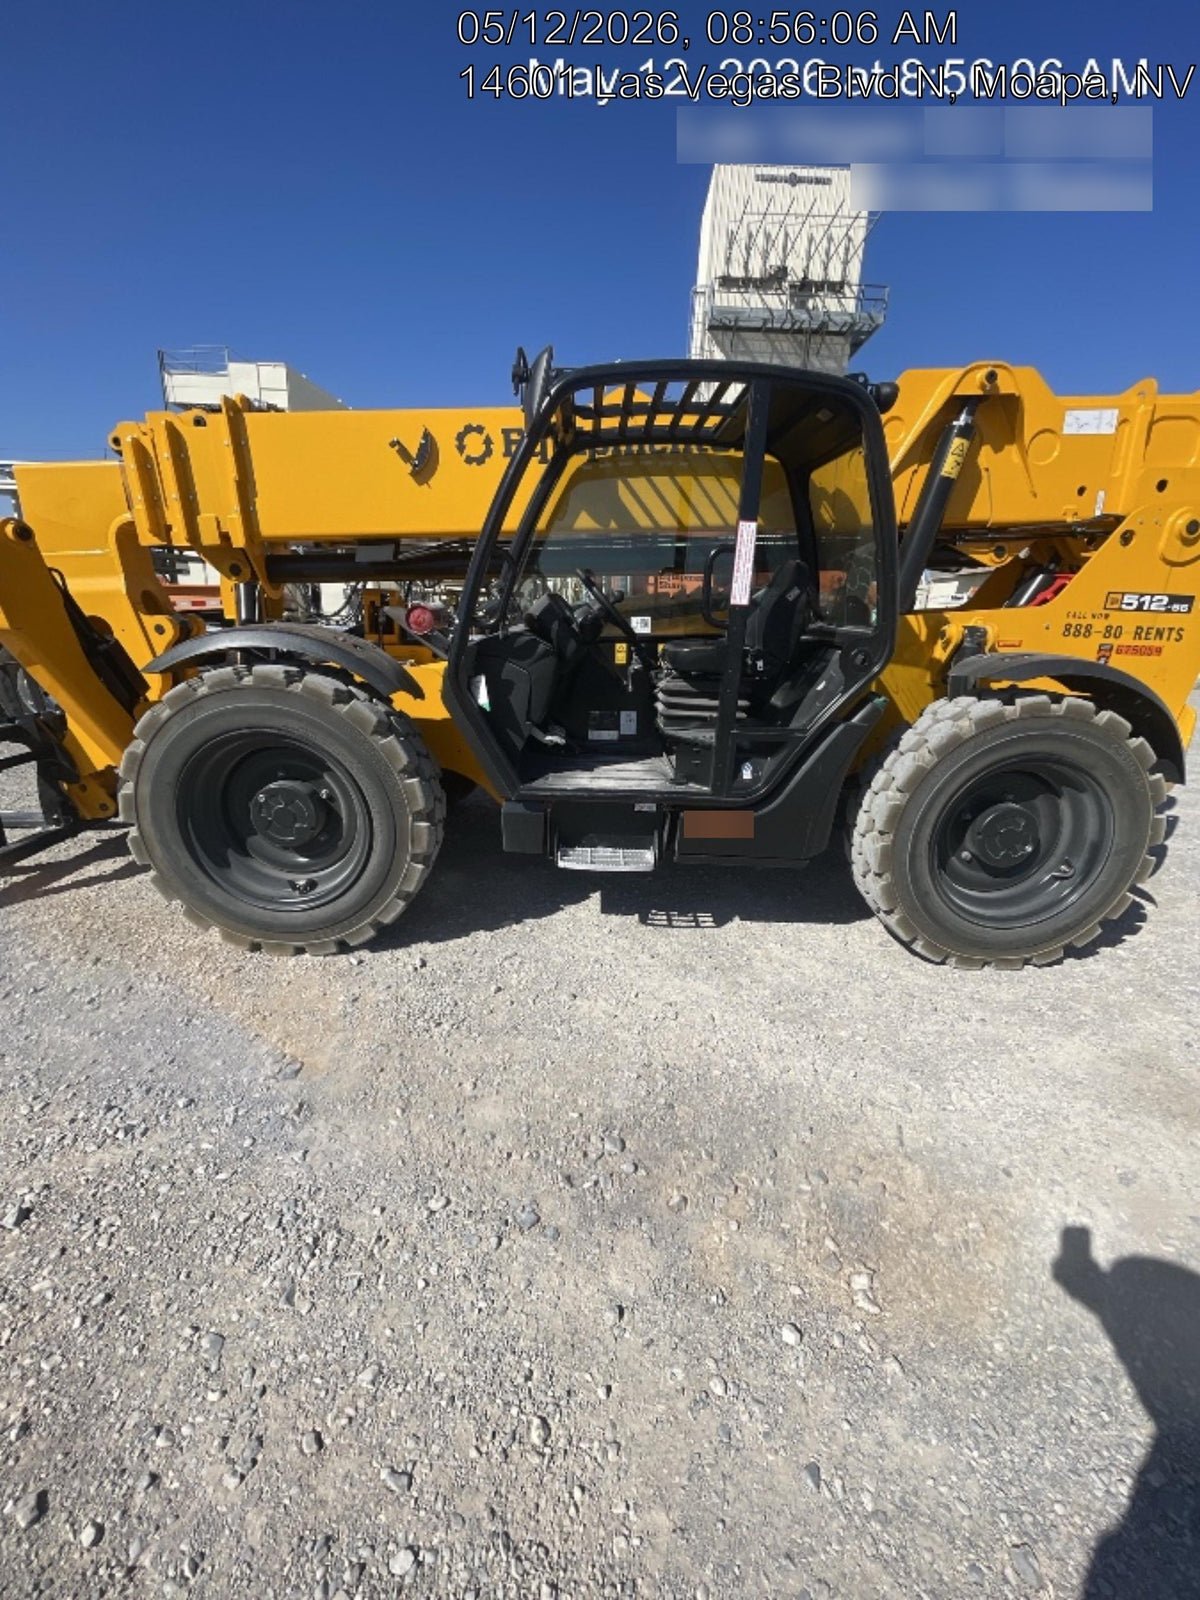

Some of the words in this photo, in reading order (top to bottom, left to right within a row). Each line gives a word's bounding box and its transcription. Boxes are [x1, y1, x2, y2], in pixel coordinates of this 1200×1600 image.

[1066, 611, 1088, 619] CALL
[1091, 612, 1111, 620] NOW
[1062, 622, 1124, 639] 888-80
[1132, 625, 1185, 642] RENTS
